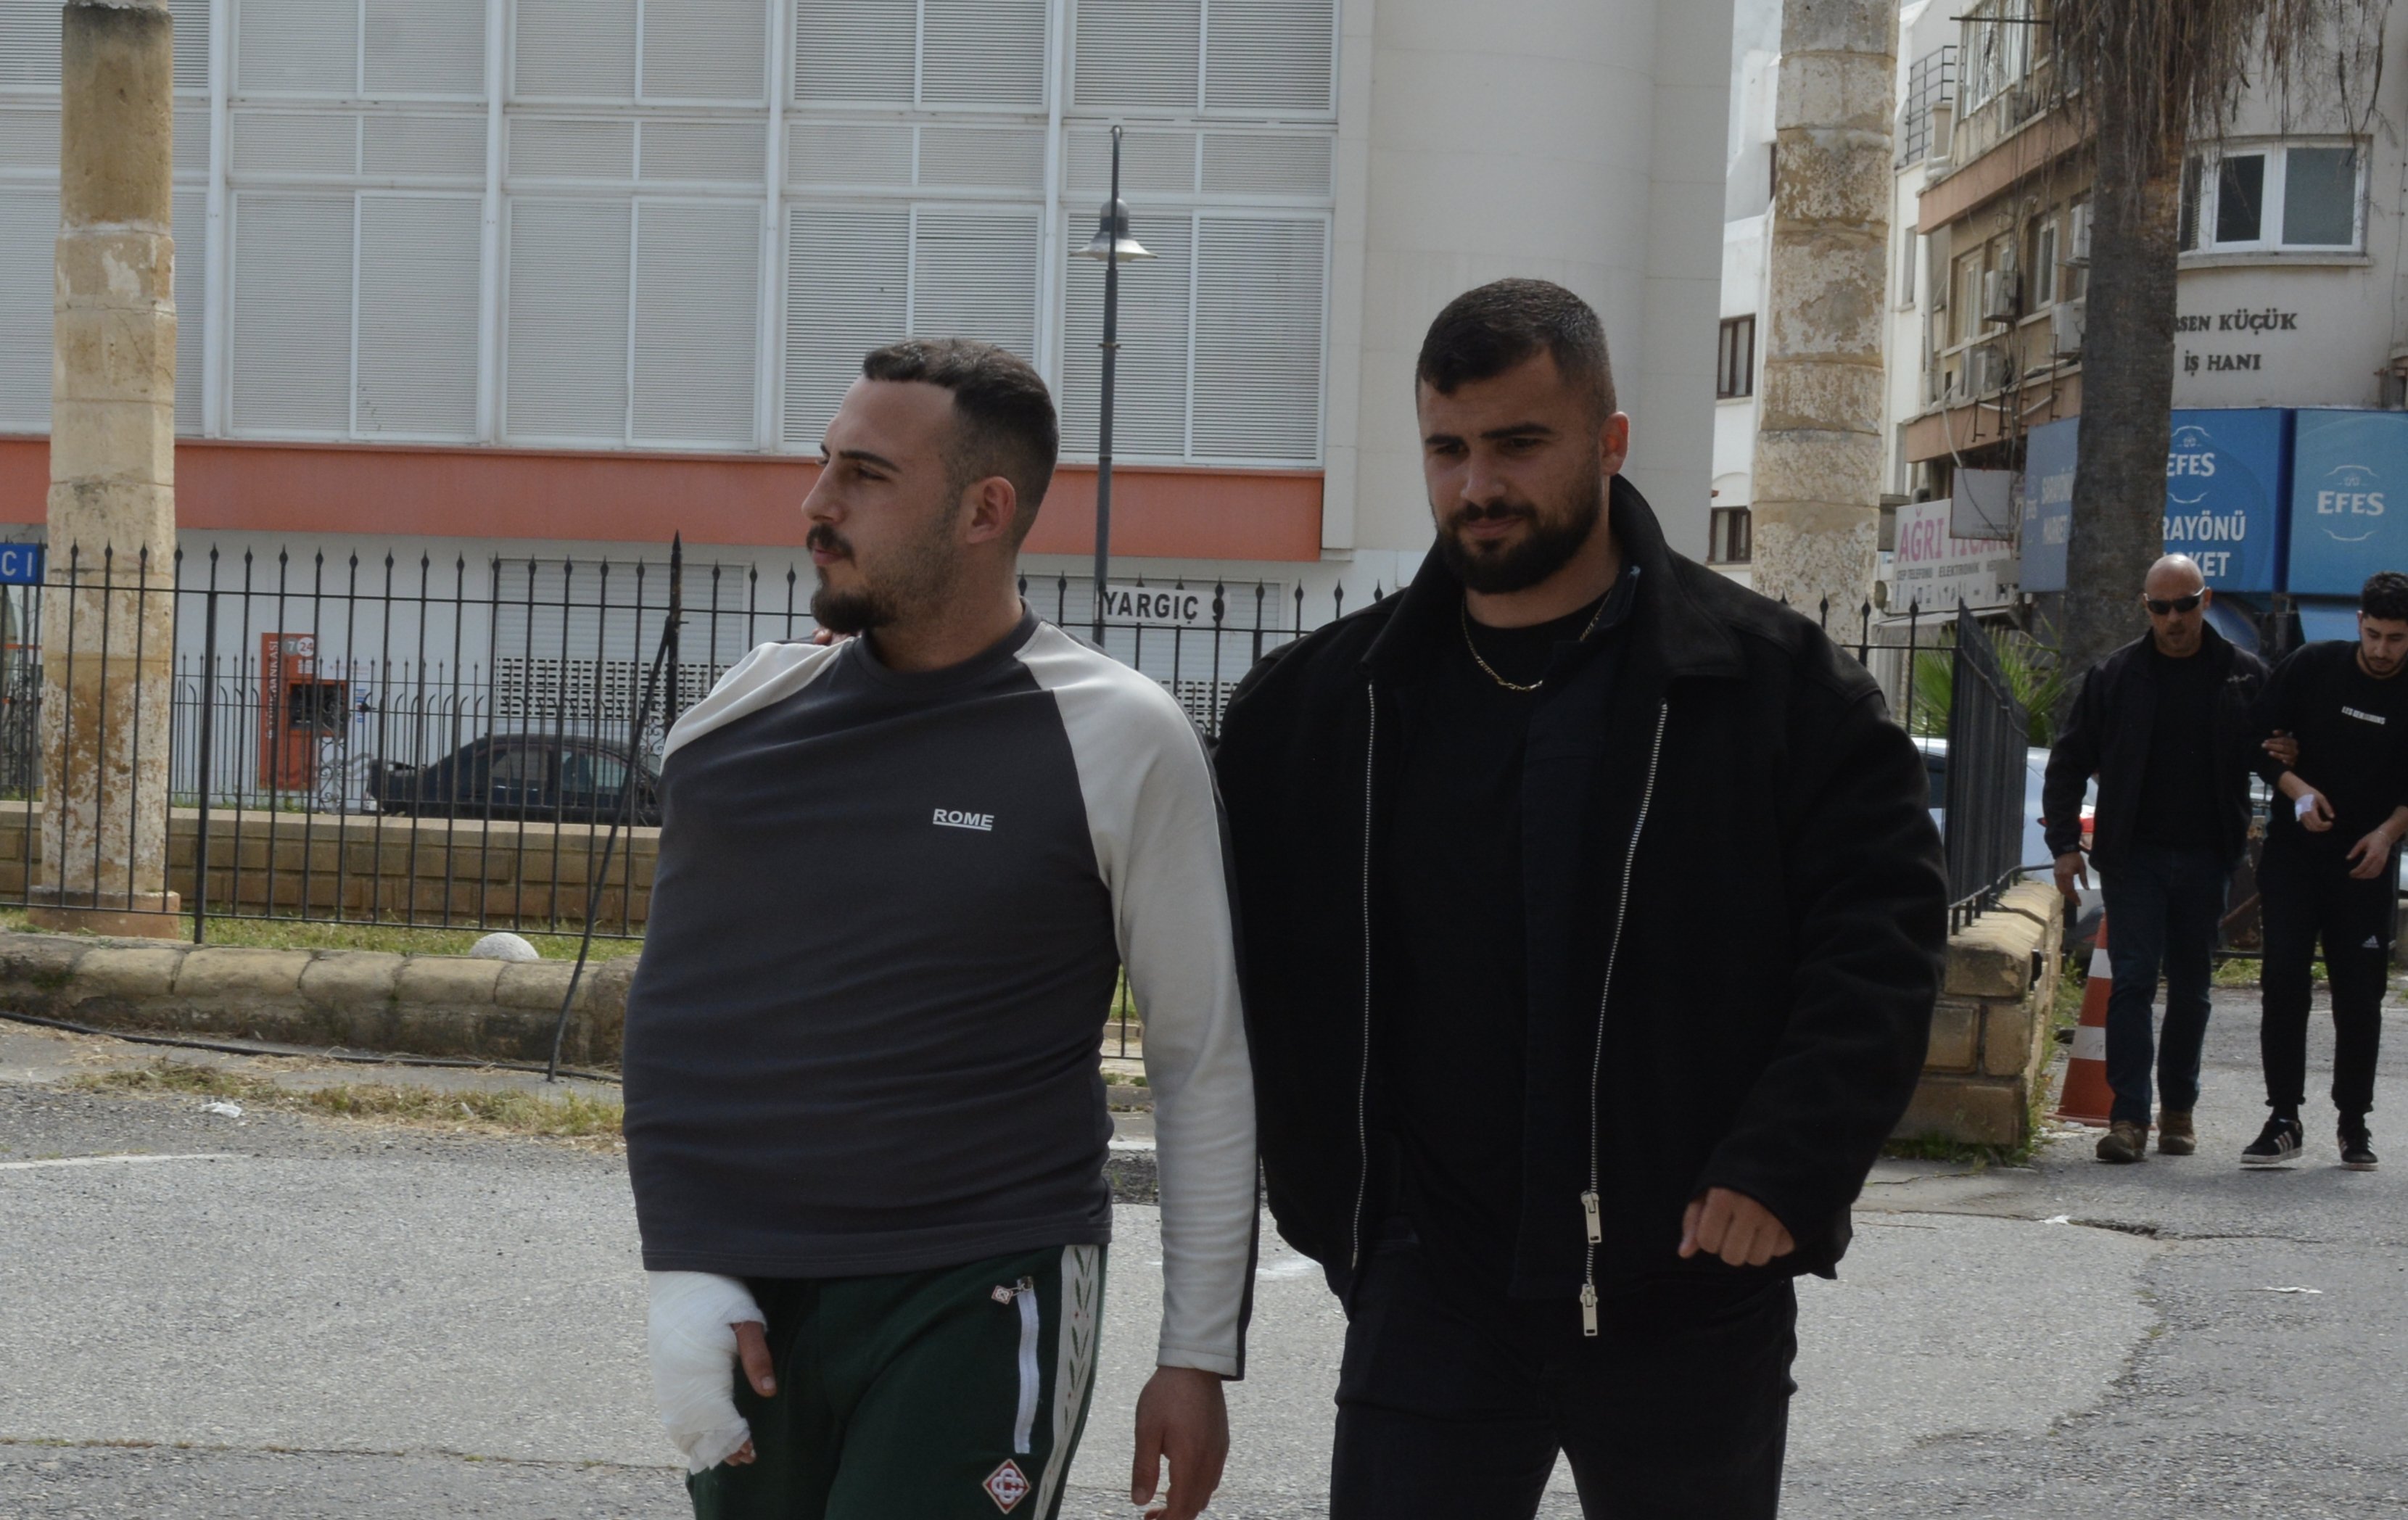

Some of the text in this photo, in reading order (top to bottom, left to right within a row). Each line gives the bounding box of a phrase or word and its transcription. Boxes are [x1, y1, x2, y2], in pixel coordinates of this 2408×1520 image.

[2219, 307, 2297, 335] KÜÇÜK
[2184, 350, 2261, 376] İŞ HANI
[2166, 453, 2216, 476] EFES
[2317, 490, 2385, 516] EFES
[1898, 509, 1945, 563] AĞRI
[1103, 591, 1199, 624] YARGIÇ
[288, 641, 313, 652] 7 24
[933, 809, 994, 830] ROME
